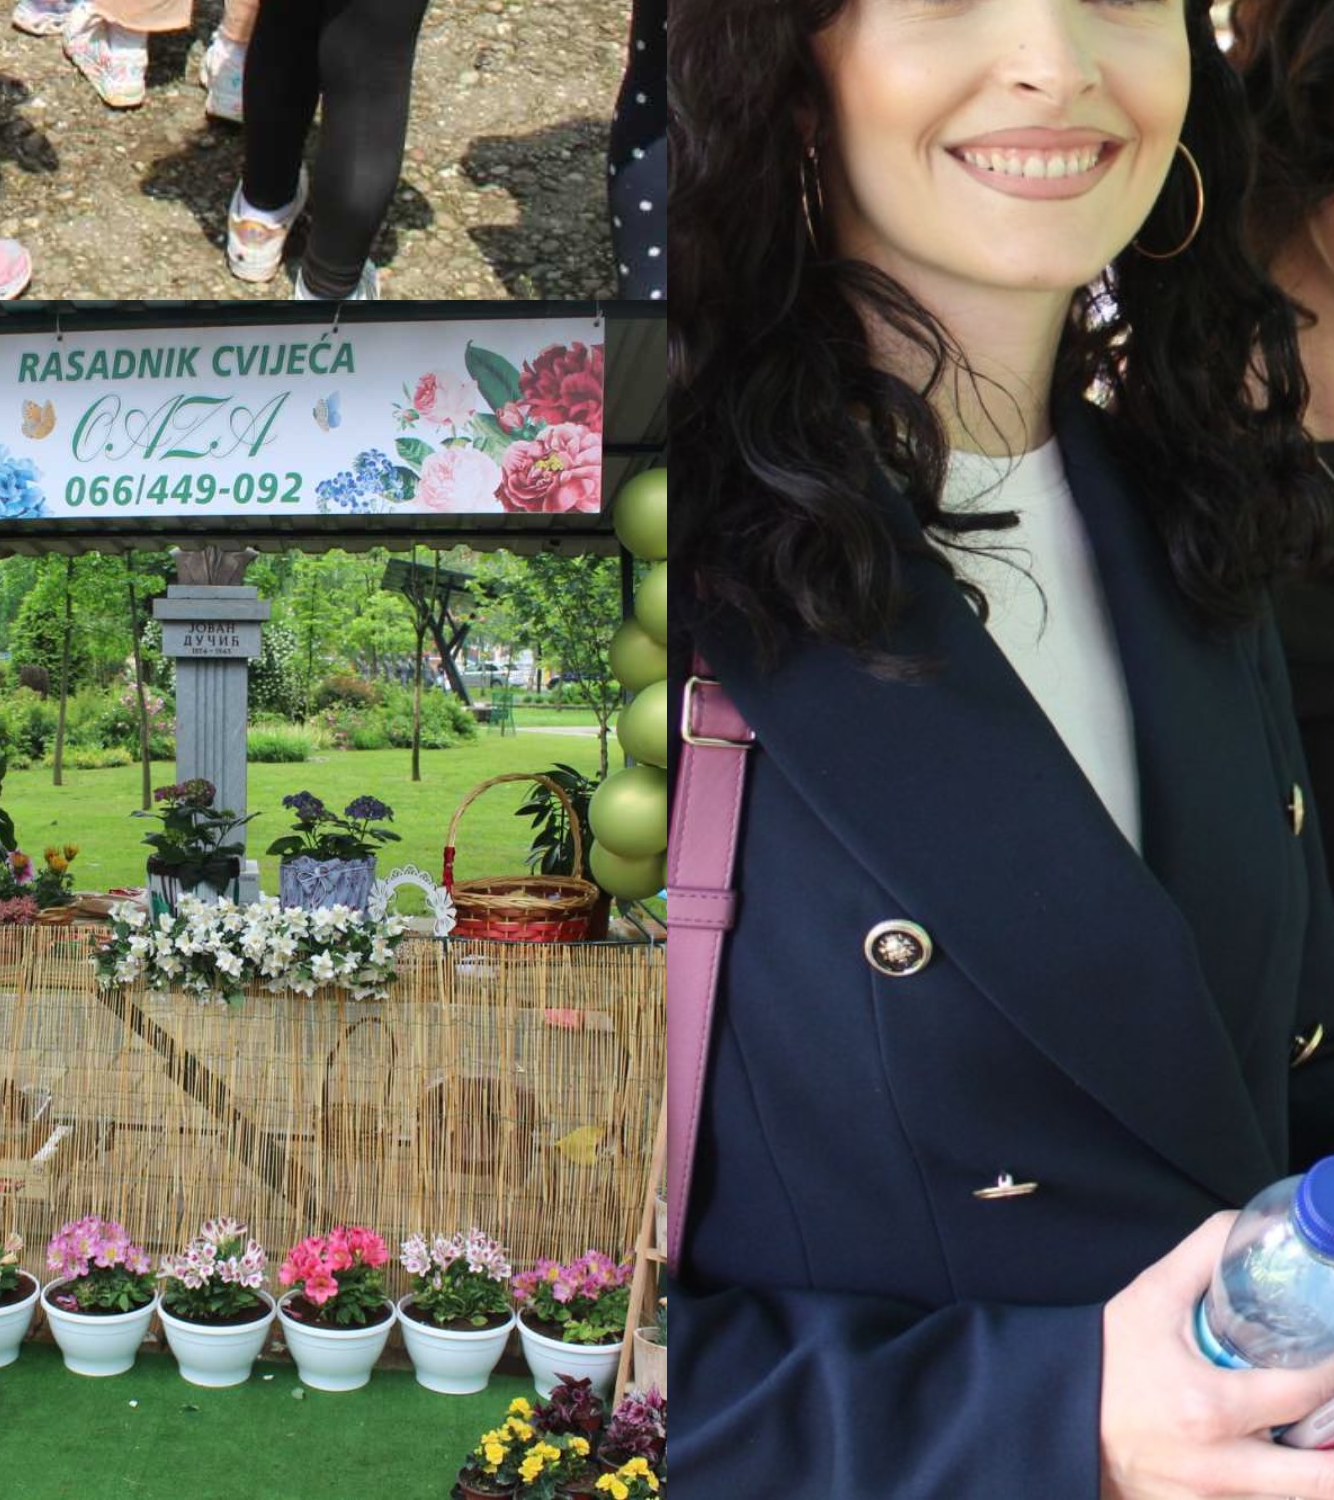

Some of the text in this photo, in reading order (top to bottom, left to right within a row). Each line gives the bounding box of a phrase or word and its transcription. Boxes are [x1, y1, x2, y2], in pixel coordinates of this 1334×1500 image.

[17, 333, 356, 383] RASADNIK CVIJEĆA
[71, 391, 292, 463] OAZA
[64, 471, 303, 507] 066/449-092
[183, 635, 240, 647] ДУЧИЋ
